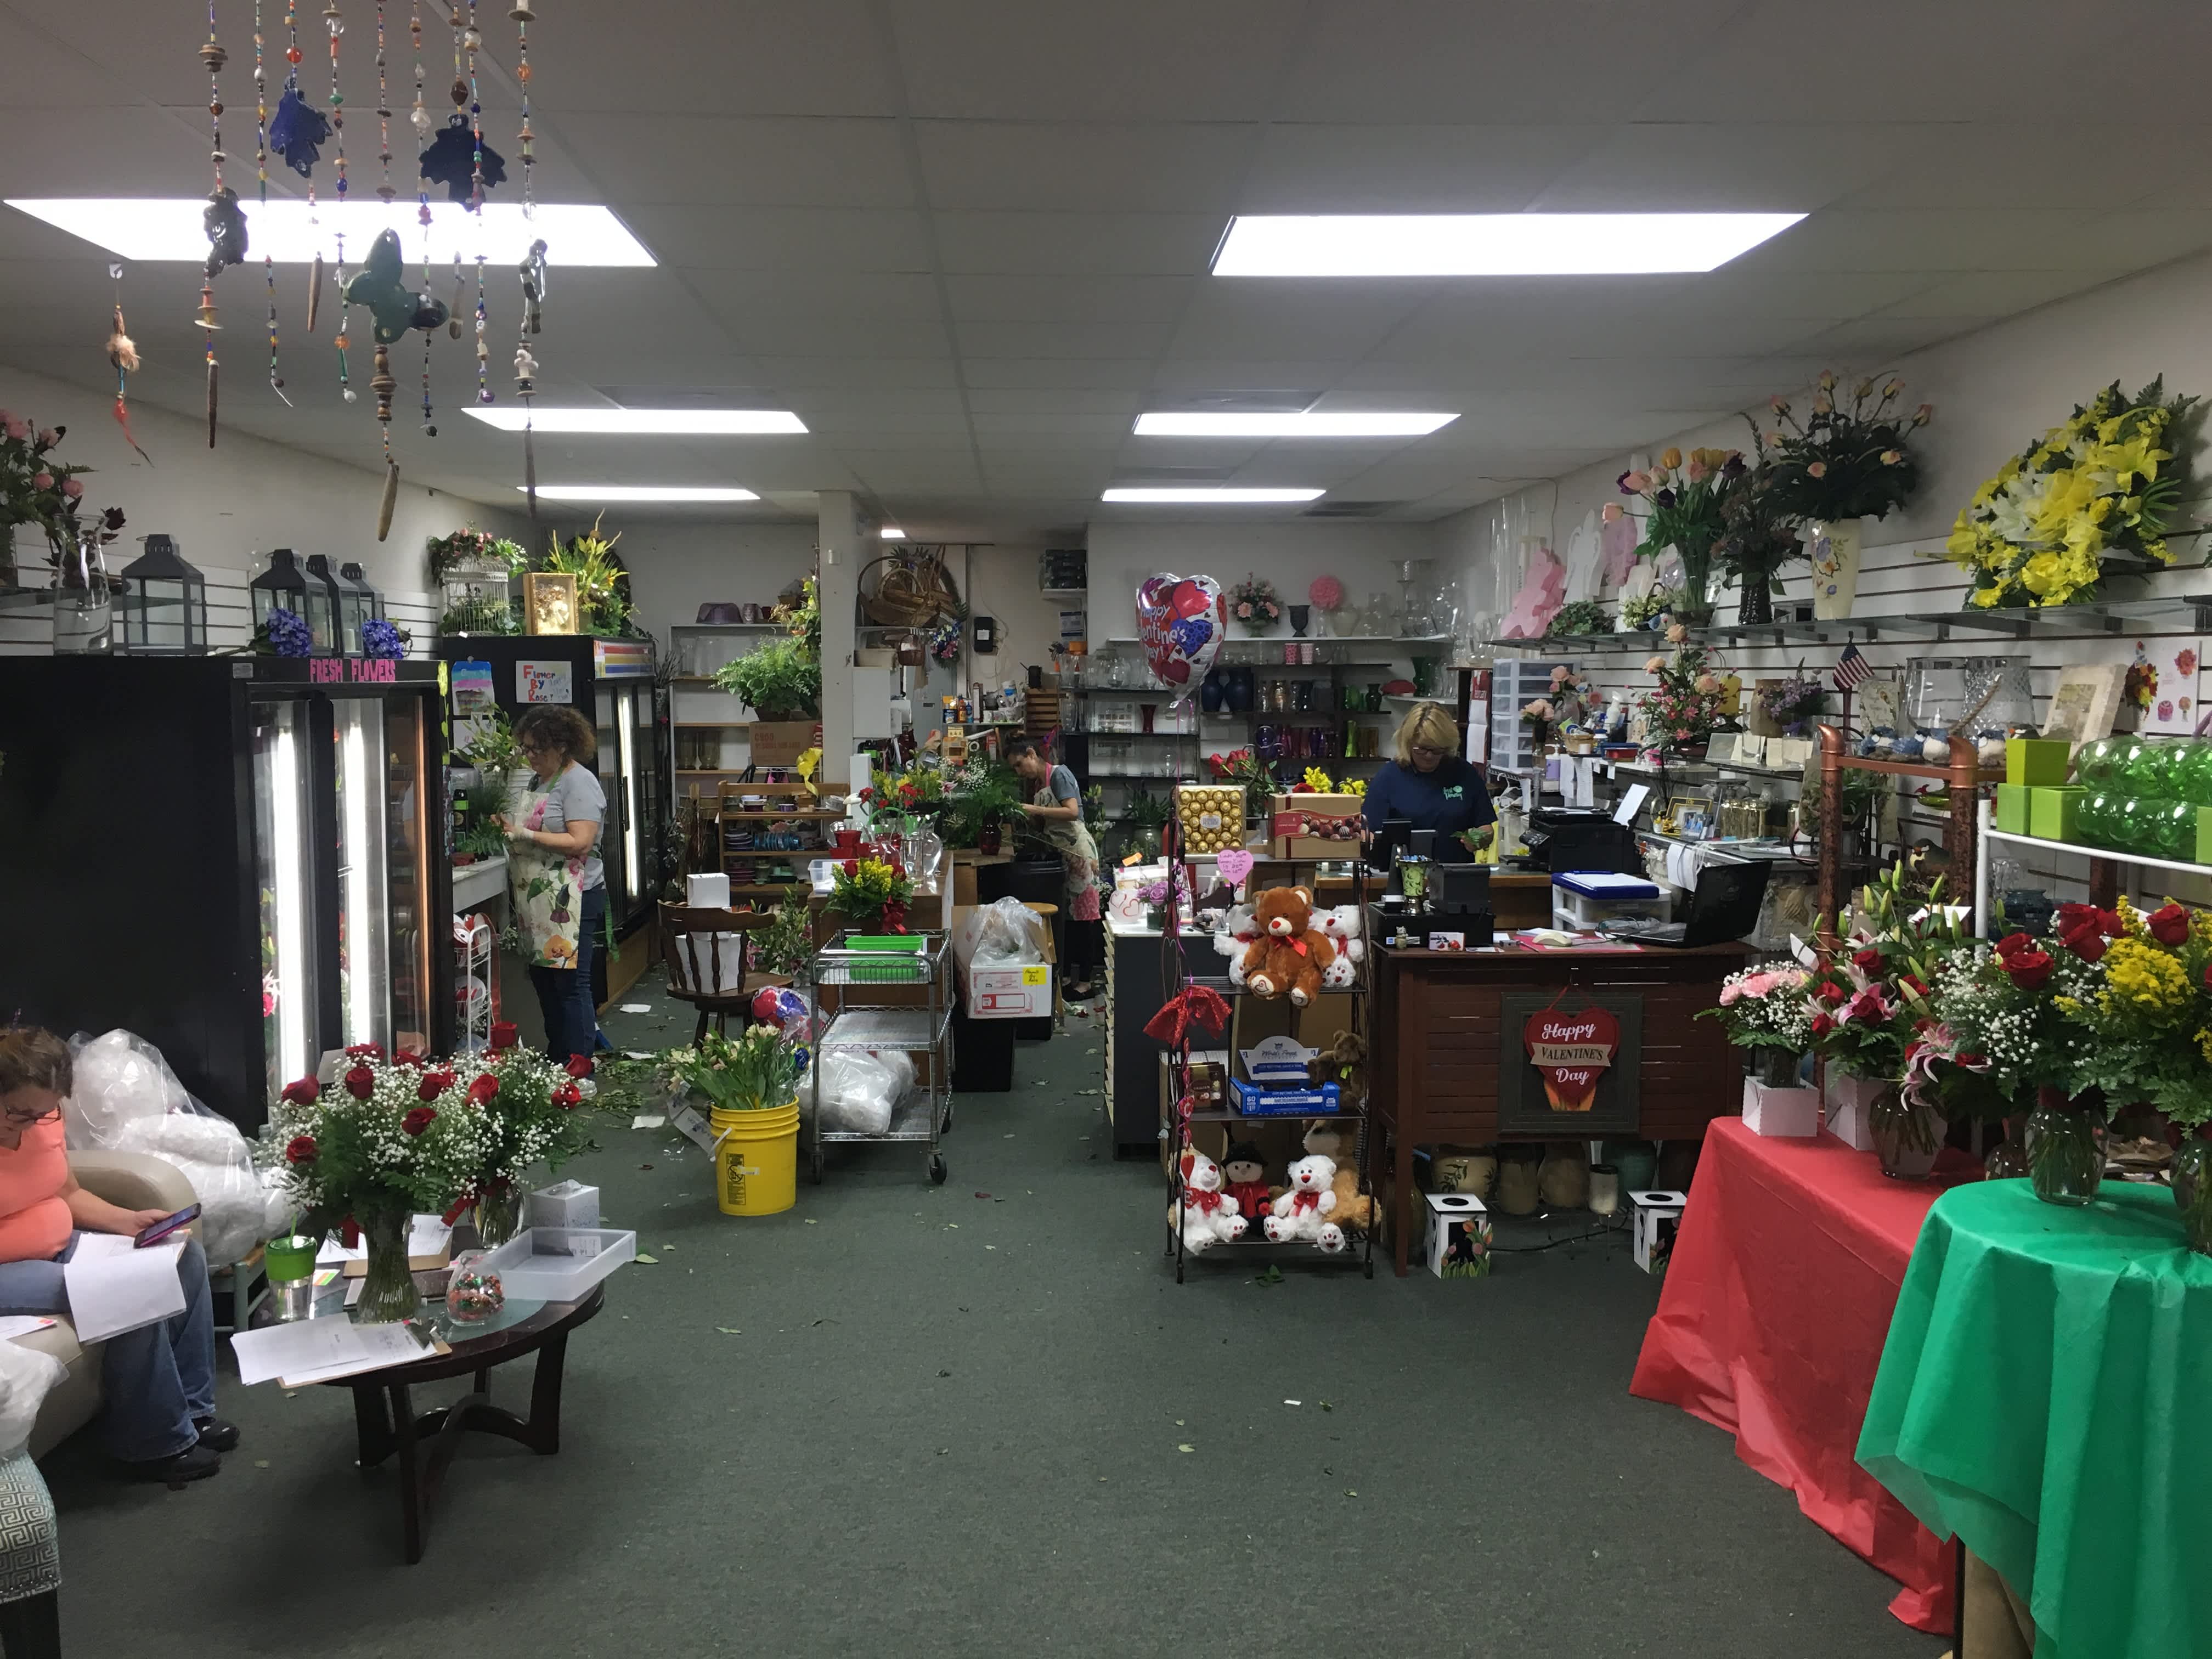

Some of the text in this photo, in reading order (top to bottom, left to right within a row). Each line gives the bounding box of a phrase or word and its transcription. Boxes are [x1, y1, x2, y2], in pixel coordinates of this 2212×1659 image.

[310, 658, 396, 683] FRESH FLOWERS
[1541, 1023, 1596, 1042] Happy
[1541, 1046, 1604, 1061] VALENTINE'S
[1555, 1068, 1589, 1086] Day
